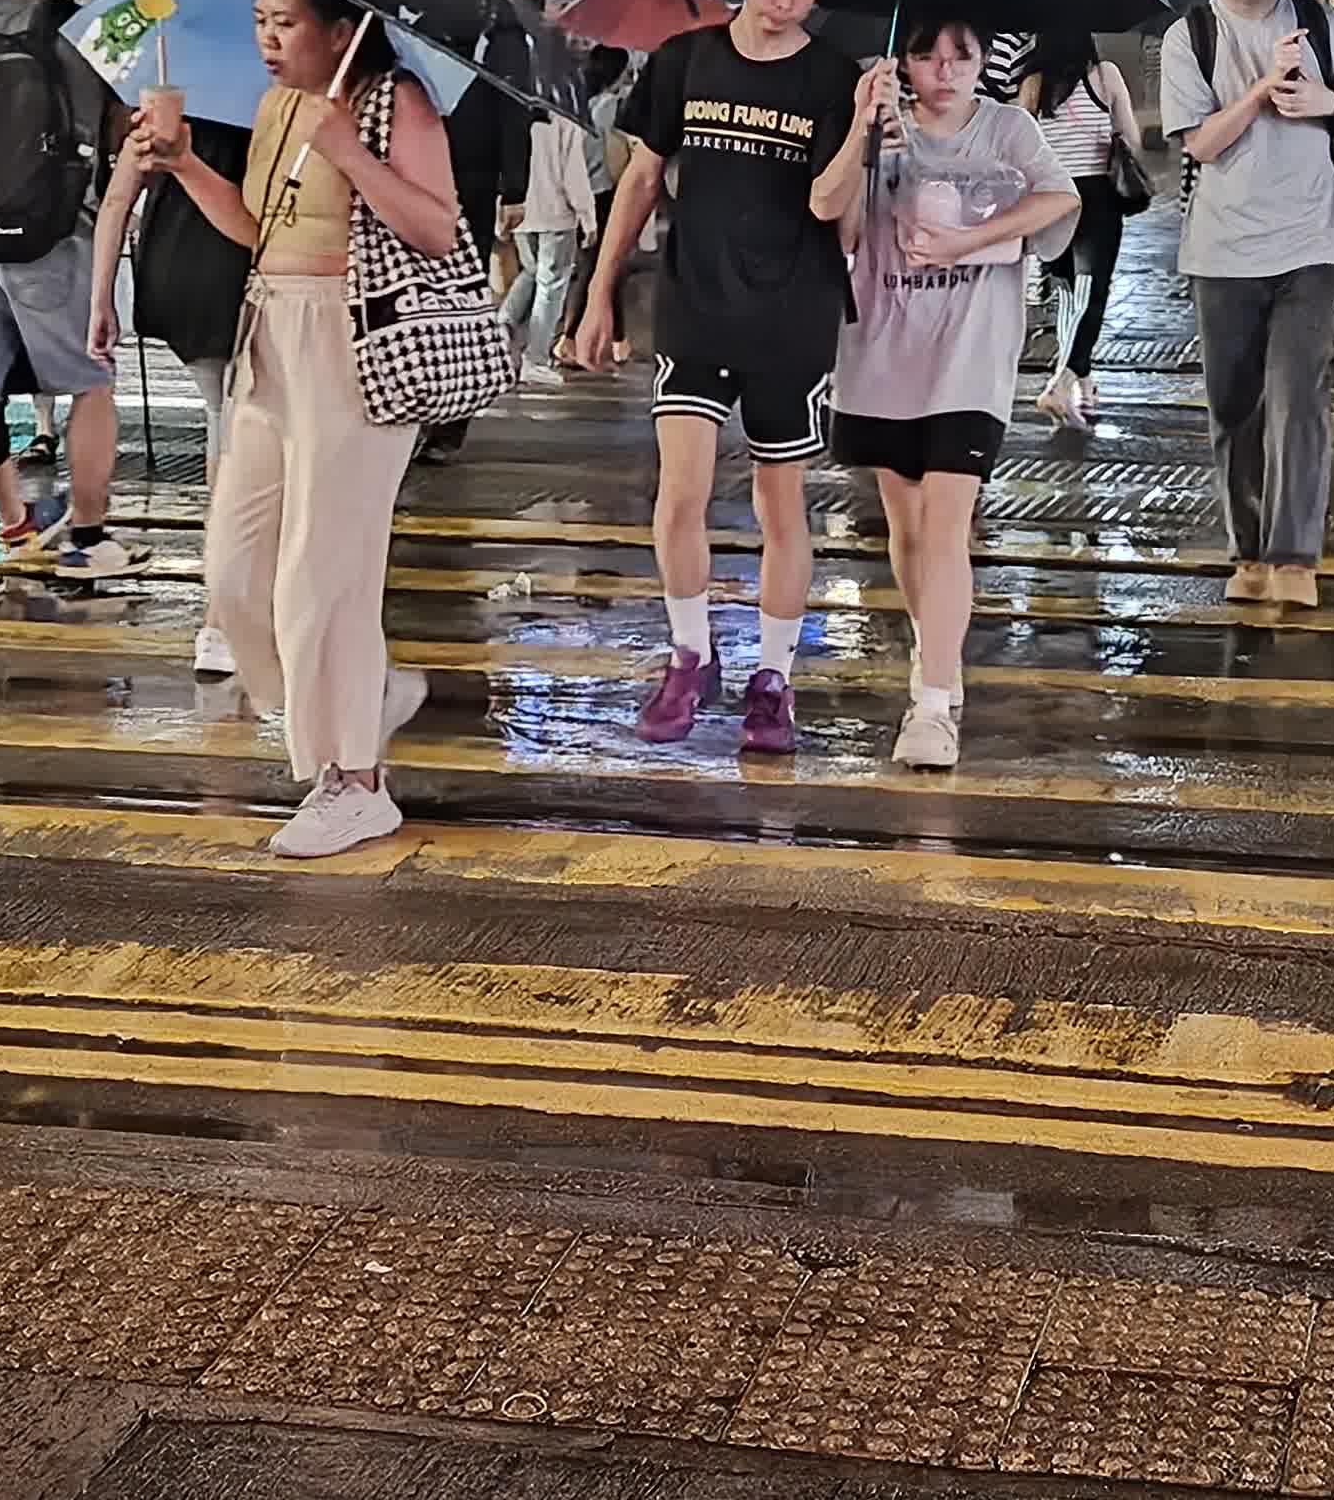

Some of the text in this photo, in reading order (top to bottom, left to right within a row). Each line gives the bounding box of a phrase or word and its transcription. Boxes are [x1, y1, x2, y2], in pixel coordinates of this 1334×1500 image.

[732, 104, 779, 130] FUNG
[779, 112, 814, 139] LING
[682, 133, 767, 157] ASKETBALL
